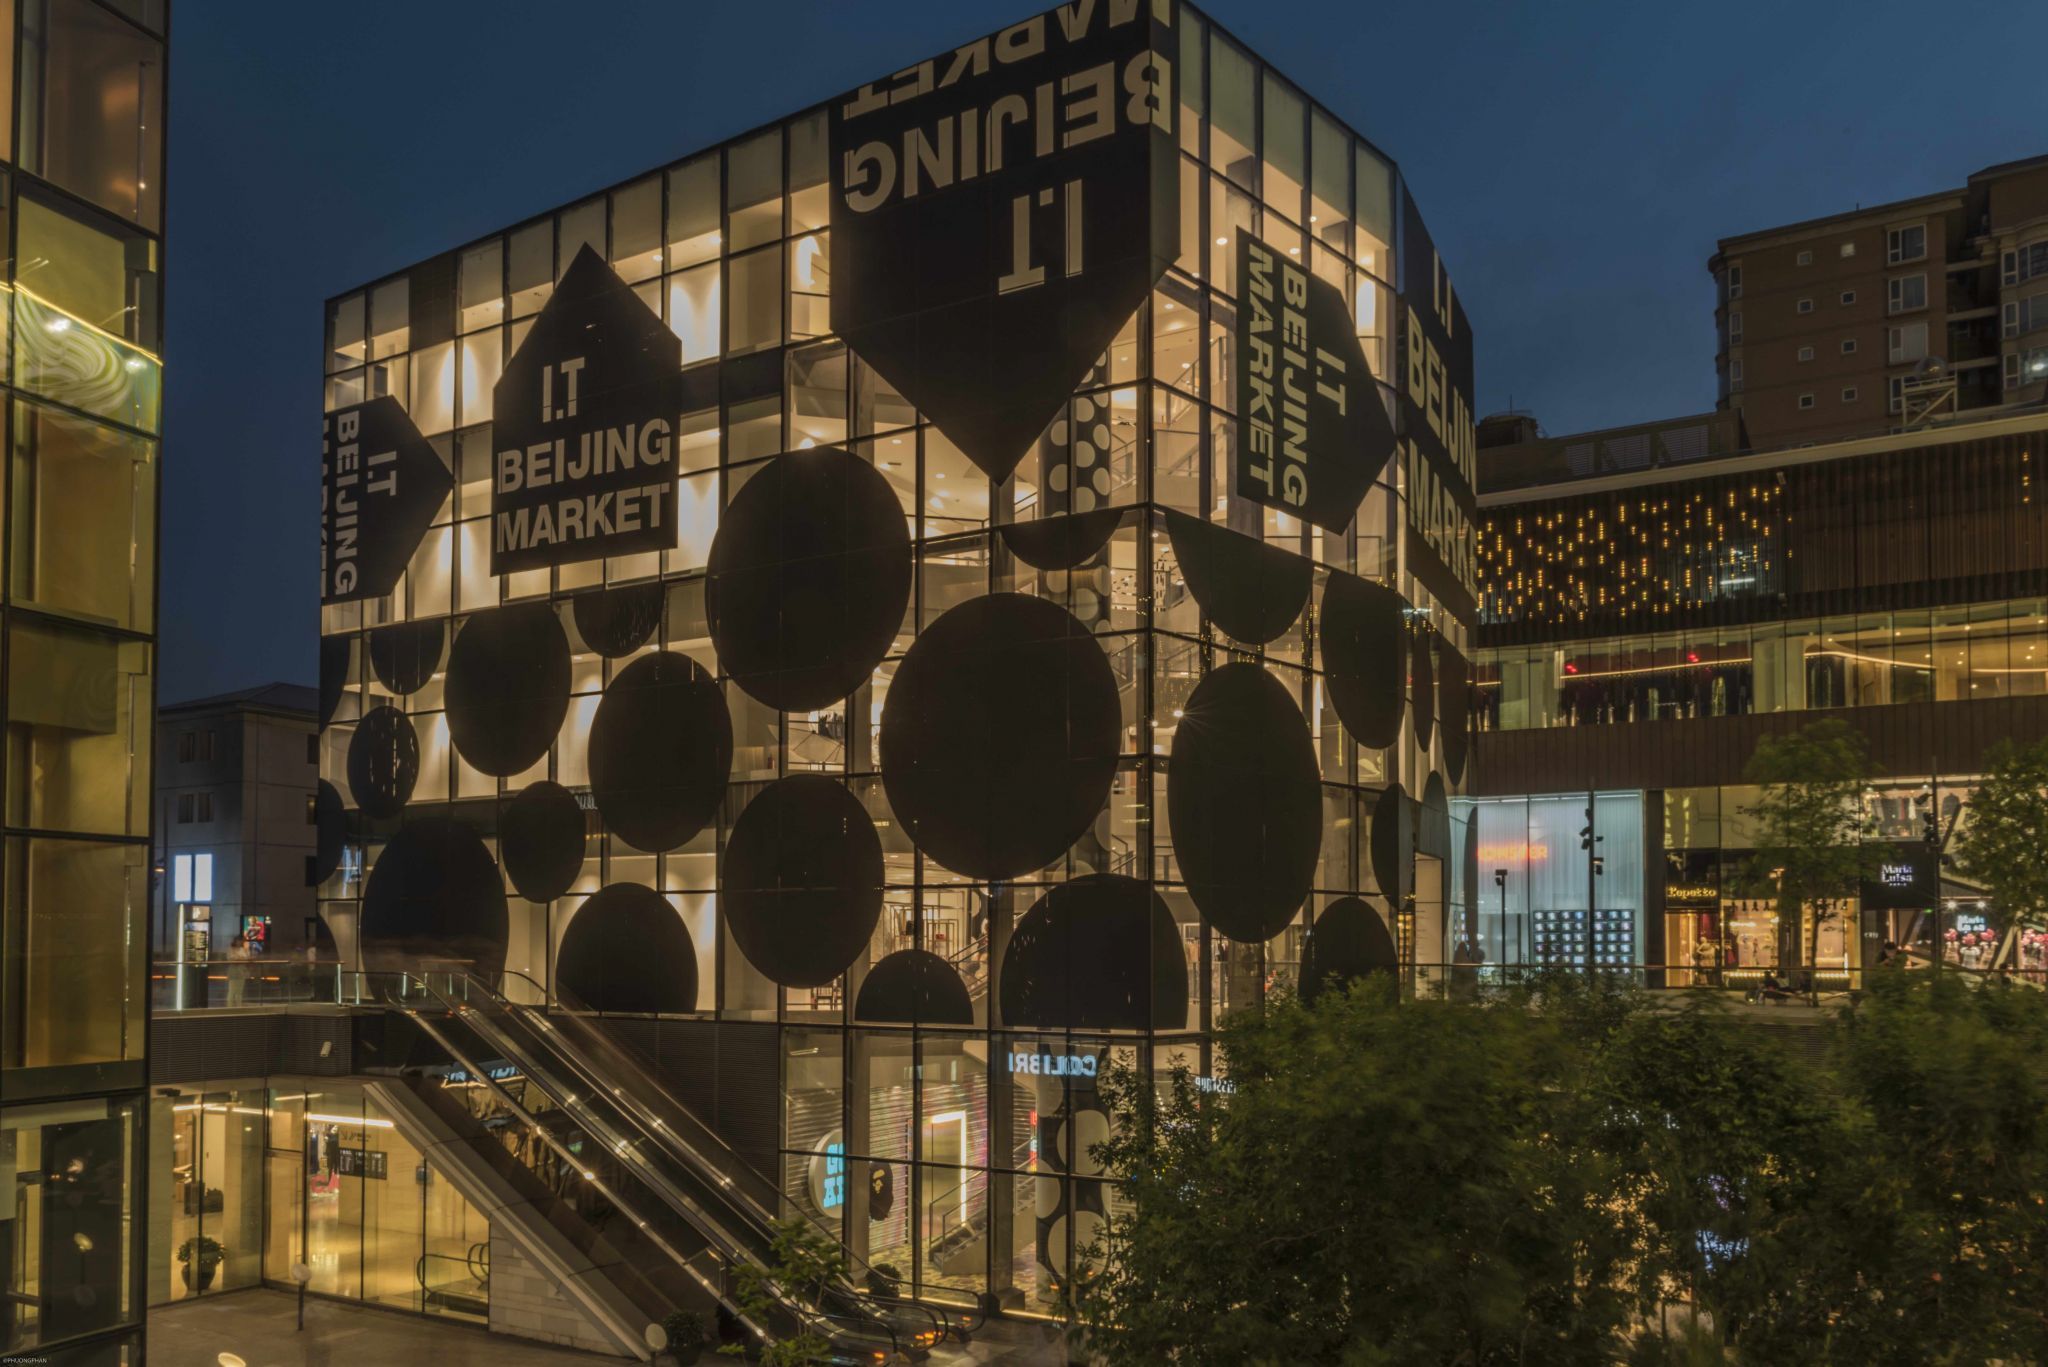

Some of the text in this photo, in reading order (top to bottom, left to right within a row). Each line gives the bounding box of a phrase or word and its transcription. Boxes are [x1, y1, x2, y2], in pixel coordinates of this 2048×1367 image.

[843, 50, 1171, 214] BEIJING
[999, 179, 1083, 295] I.T
[543, 356, 585, 423] I.T
[1249, 242, 1274, 497] MARKET
[1283, 263, 1308, 507] BEIJING
[1316, 346, 1346, 416] I.T
[335, 410, 360, 595] BEIJING
[367, 451, 397, 496] I.T
[497, 418, 671, 494] BEIJING
[496, 482, 670, 553] MARKET
